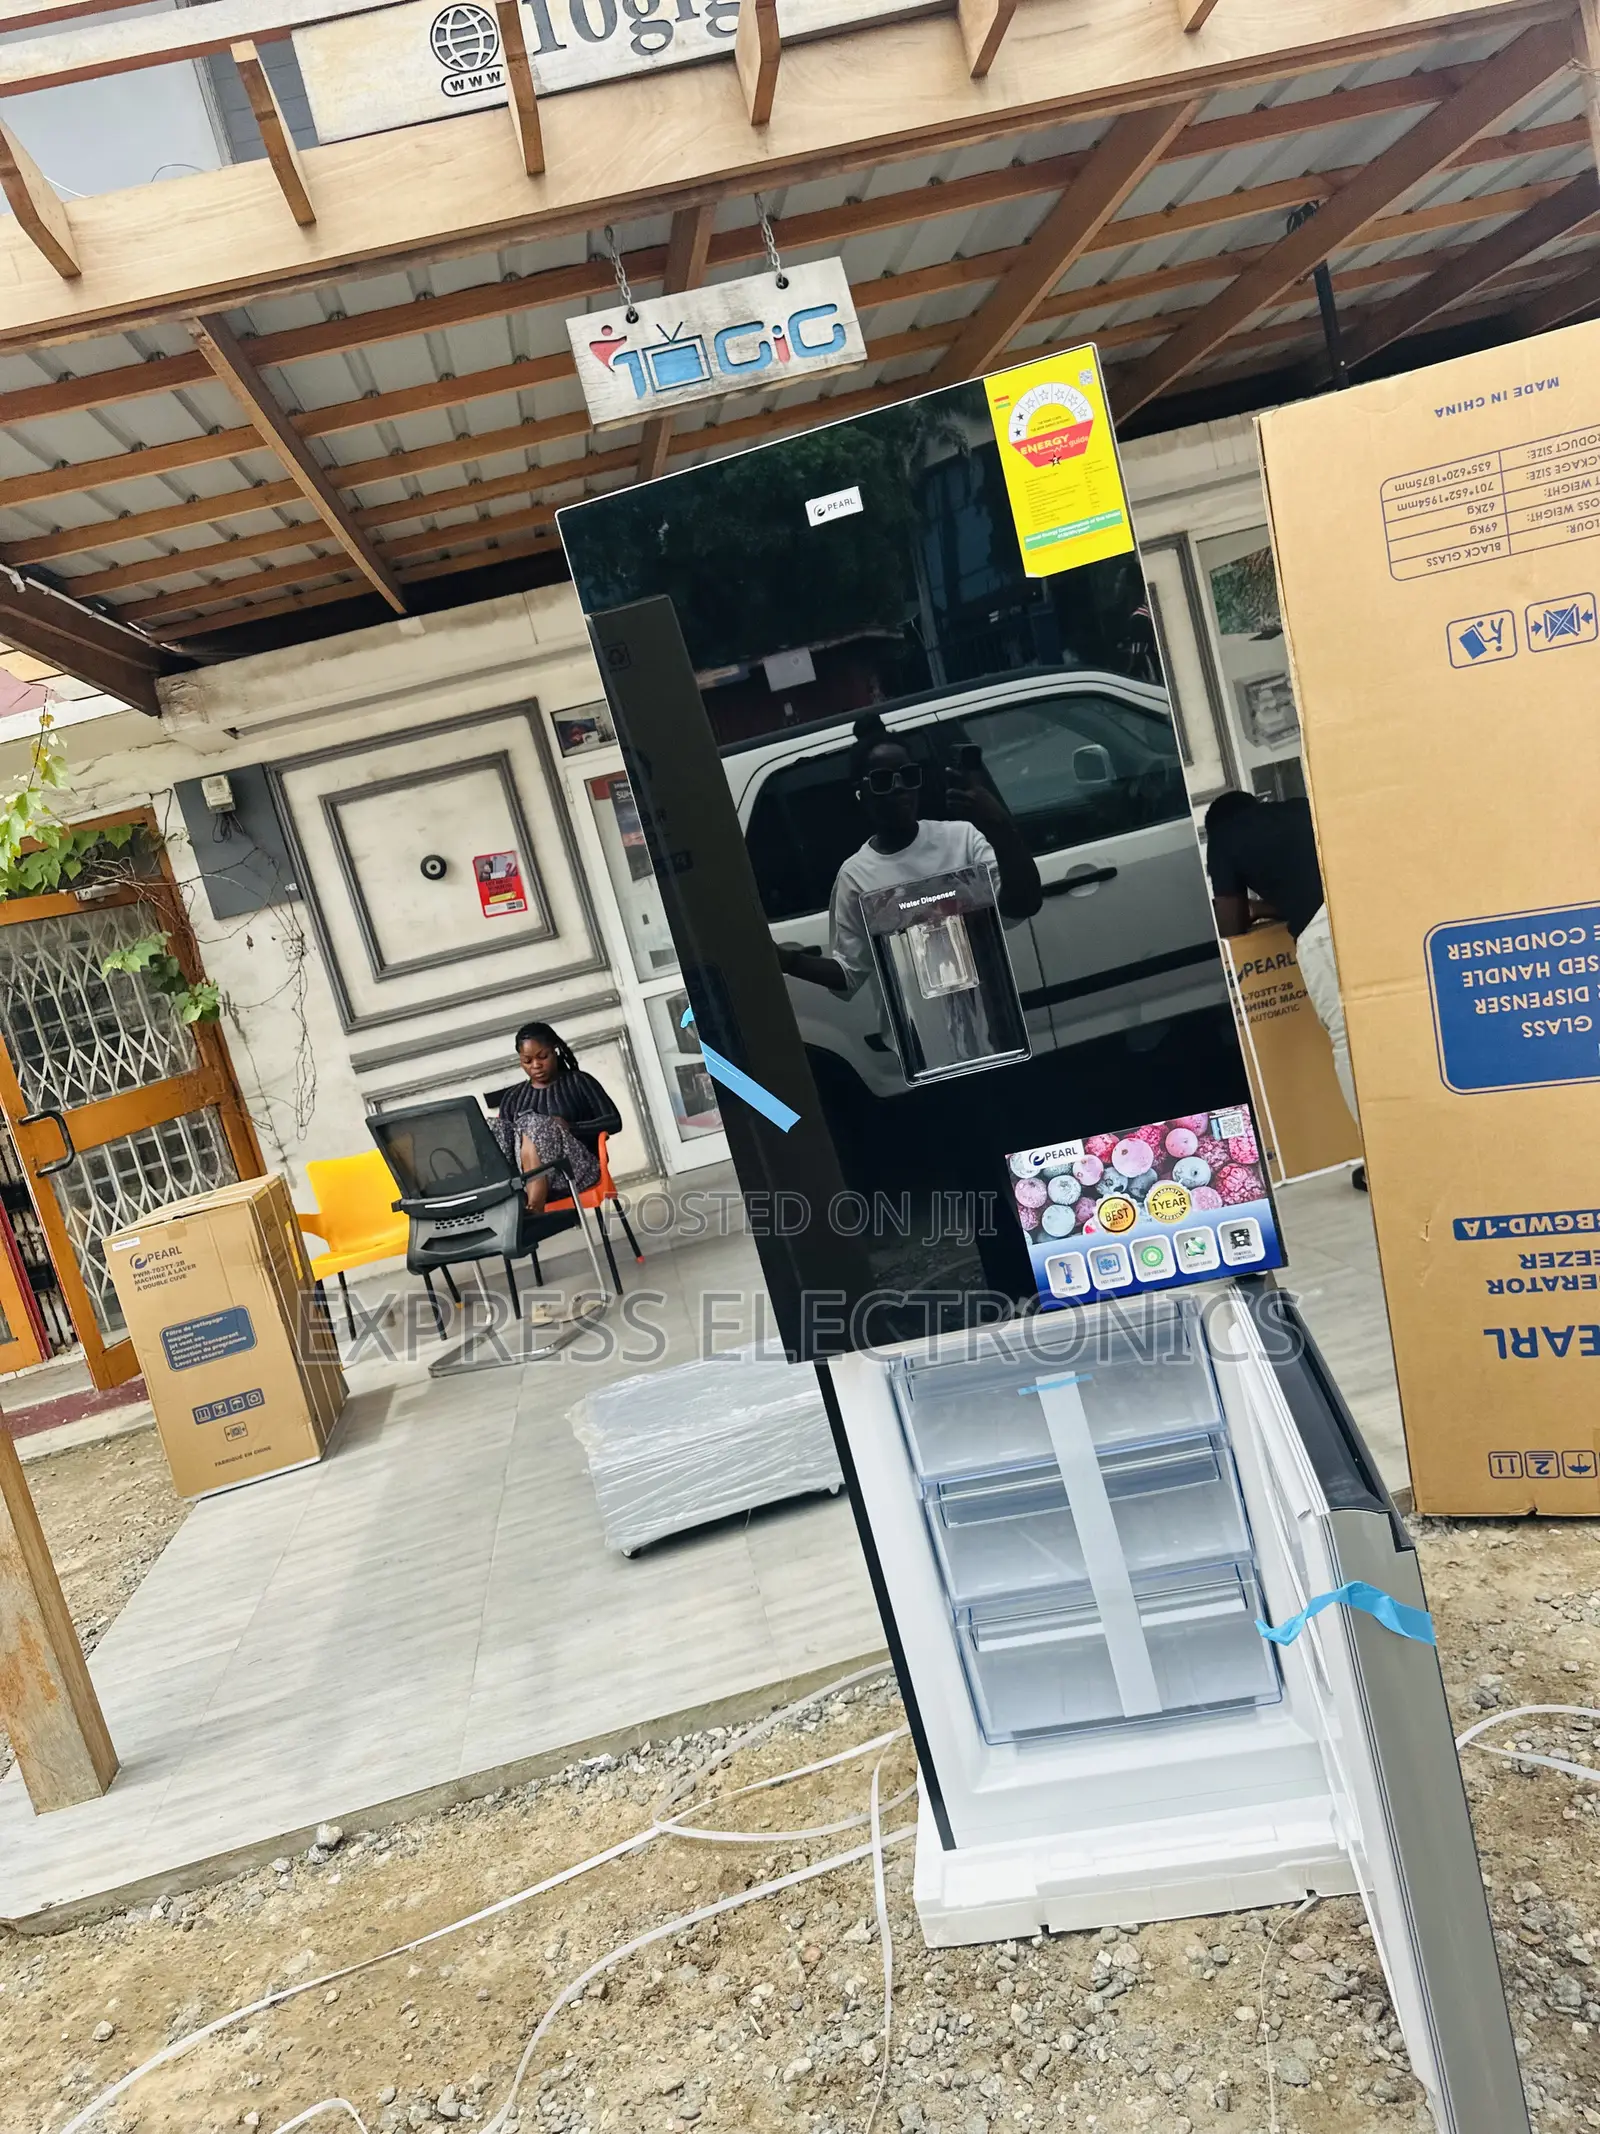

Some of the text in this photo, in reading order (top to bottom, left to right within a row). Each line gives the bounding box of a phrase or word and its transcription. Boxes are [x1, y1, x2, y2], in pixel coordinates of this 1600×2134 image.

[1434, 377, 1560, 418] MADE IN CHINA
[1020, 434, 1069, 455] ENERGY
[1527, 445, 1553, 459] SIZE:
[1525, 454, 1600, 481] CKAGE SIZE:
[1543, 479, 1591, 497] WEIGHT:
[827, 498, 856, 512] PEARL
[1466, 502, 1495, 516] 62Kg
[1526, 504, 1574, 523] WEIGHT:
[1469, 522, 1498, 535] 69Kg
[1426, 542, 1501, 567] BLACK GLASS
[898, 889, 956, 910] Water Dispenser
[1447, 927, 1586, 960] CONDENSER
[1243, 952, 1297, 977] PEARL
[1462, 962, 1550, 988] HANDLE
[1474, 985, 1590, 1015] DISPENSER
[1250, 1003, 1300, 1023] AUTOMATIC
[1521, 1015, 1593, 1038] GLASS
[1044, 1147, 1078, 1161] PEARL
[1105, 1208, 1129, 1223] BEST
[147, 1246, 182, 1262] PEARL
[134, 1271, 166, 1285] MACHINE
[174, 1263, 196, 1274] LAVER
[143, 1279, 169, 1290] DOUBLE
[170, 1273, 188, 1283] CUVE
